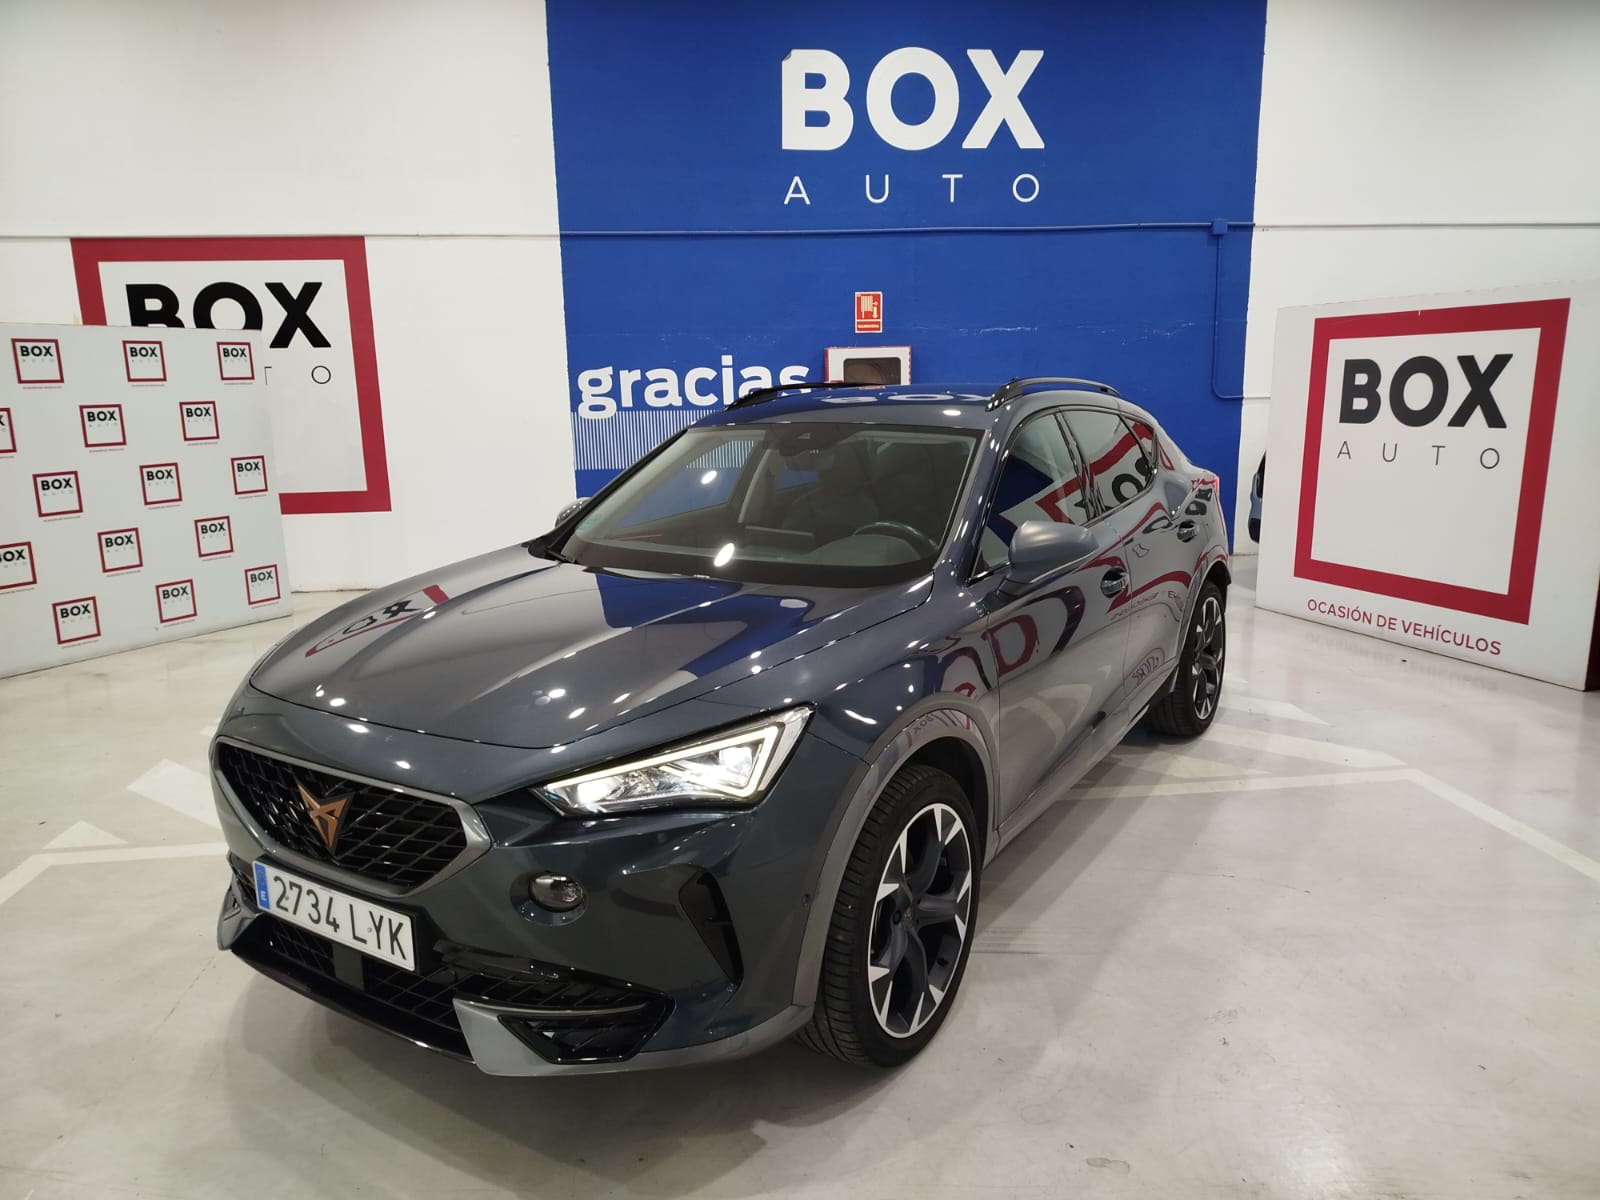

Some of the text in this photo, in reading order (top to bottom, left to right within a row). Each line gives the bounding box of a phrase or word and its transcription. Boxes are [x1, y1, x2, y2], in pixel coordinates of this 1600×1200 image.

[782, 47, 1045, 151] BOX
[784, 173, 1040, 205] AUTO
[126, 281, 331, 349] BOX
[20, 346, 53, 357] BOX
[130, 347, 157, 357] BOX
[223, 348, 246, 357] BOX
[577, 354, 812, 420] gracias
[1339, 353, 1513, 429] BOX
[87, 411, 116, 422] BOX
[186, 407, 211, 417] BOX
[1336, 440, 1501, 470] AUTO
[237, 462, 260, 472] BOX
[147, 469, 173, 481] BOX
[41, 478, 72, 491] BOX
[201, 522, 225, 534] BOX
[105, 535, 133, 547] BOX
[250, 571, 273, 582] BOX
[162, 586, 188, 599] BOX
[60, 604, 90, 618] BOX
[1307, 599, 1502, 656] OCASIÓN DE VEHÍCULOS
[273, 875, 407, 961] 2734 LYK
